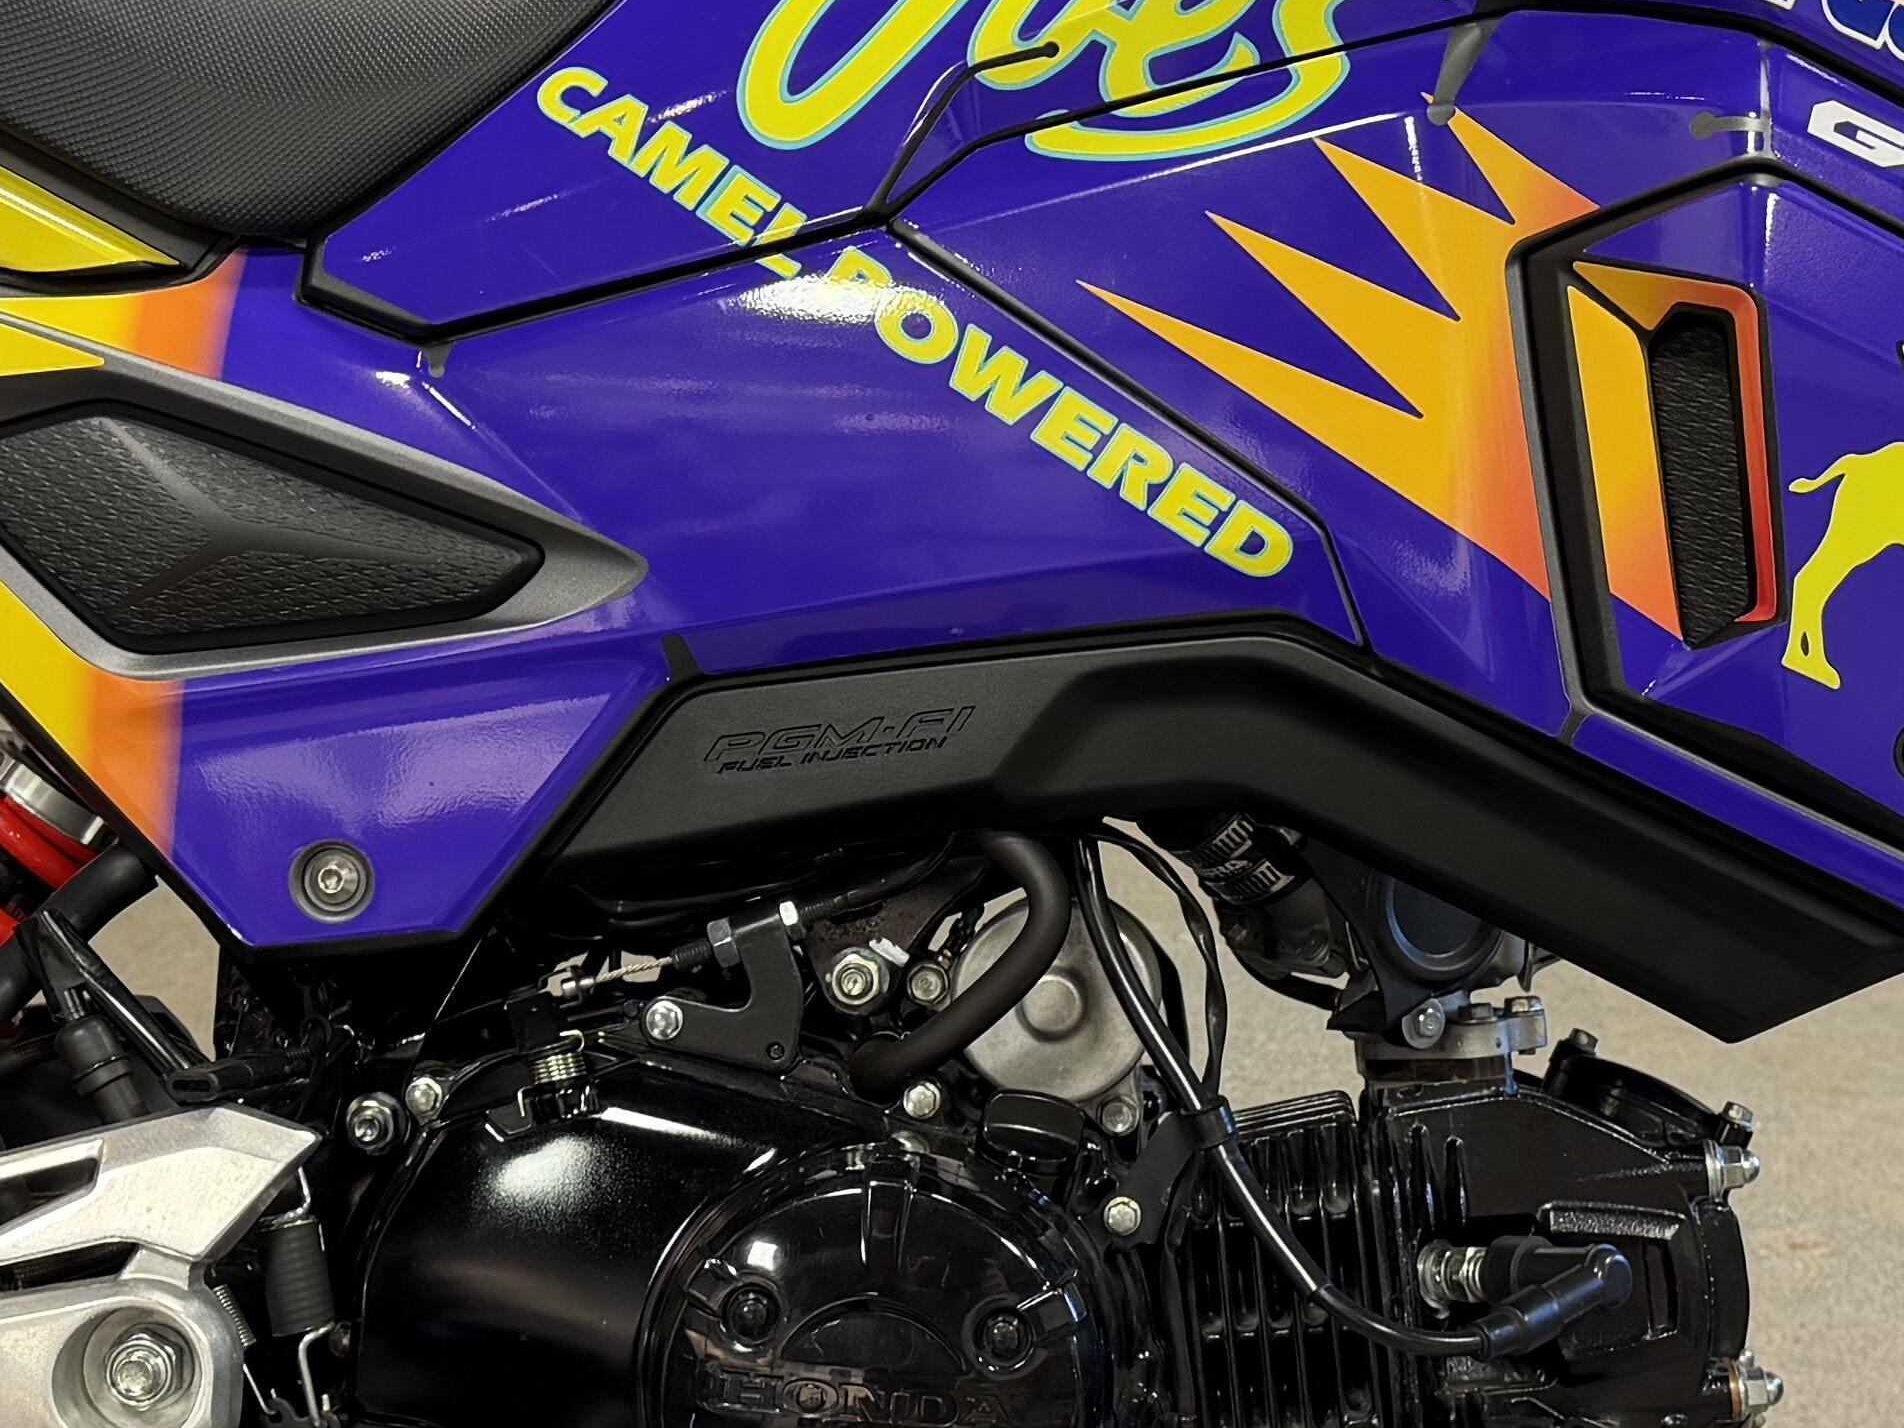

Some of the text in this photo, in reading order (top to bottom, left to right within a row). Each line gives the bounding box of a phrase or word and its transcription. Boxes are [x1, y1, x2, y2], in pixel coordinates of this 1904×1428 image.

[536, 64, 1294, 578] CAMEL POWERED
[703, 705, 977, 763] PGM-FI
[717, 736, 948, 774] FUEL INJECTION
